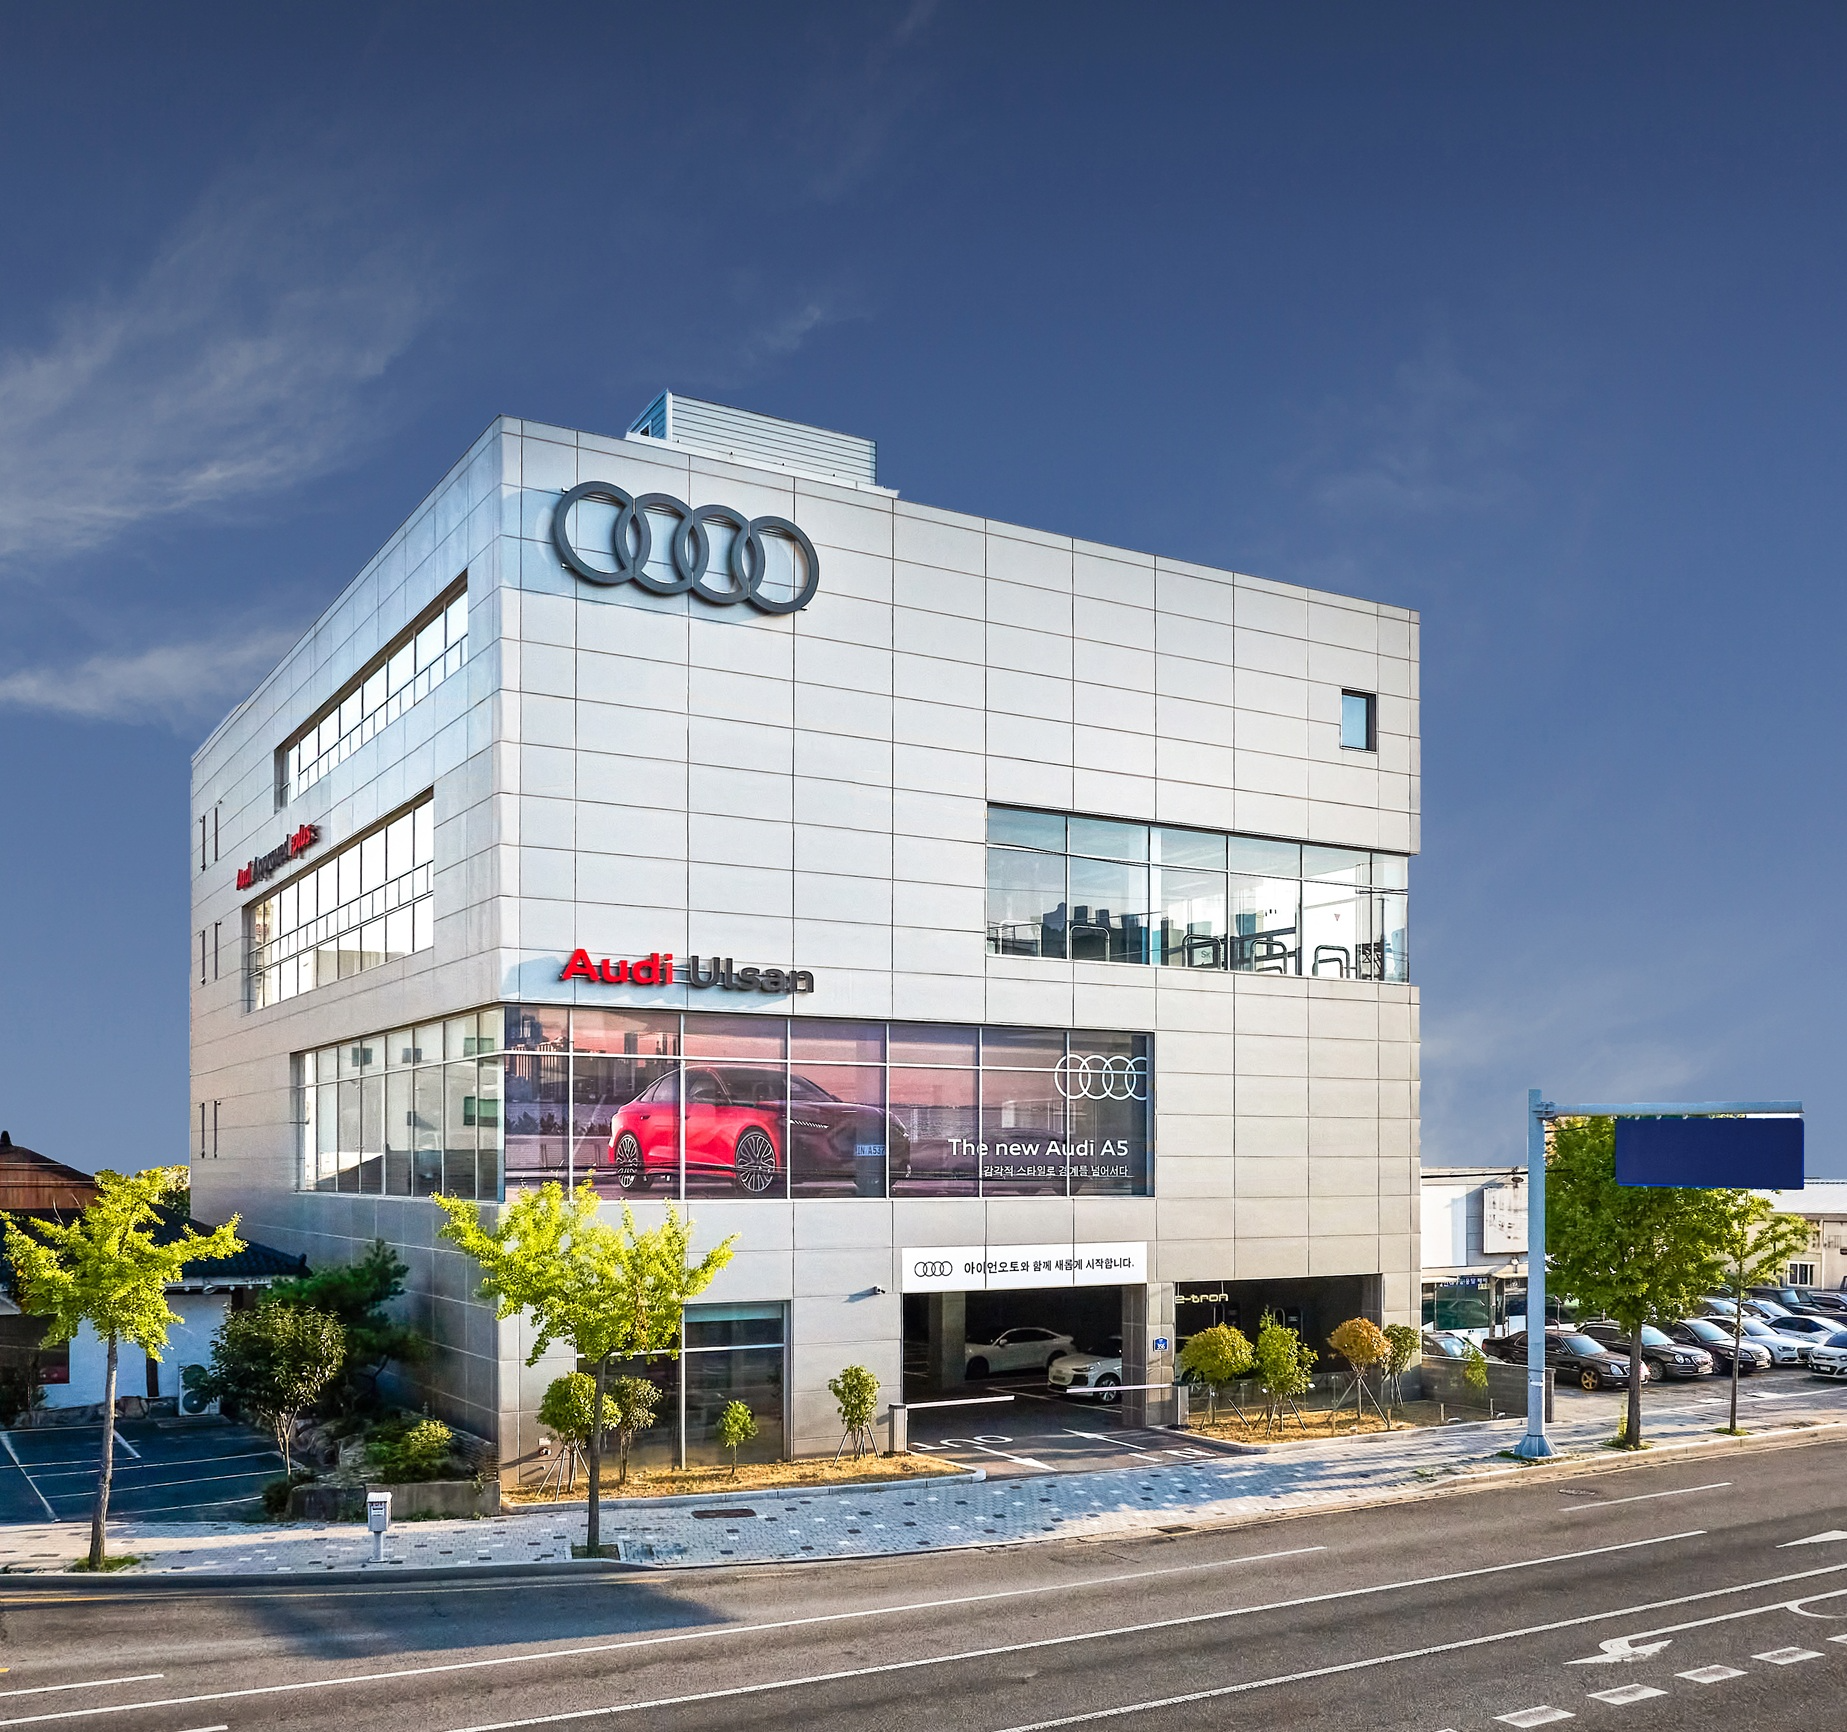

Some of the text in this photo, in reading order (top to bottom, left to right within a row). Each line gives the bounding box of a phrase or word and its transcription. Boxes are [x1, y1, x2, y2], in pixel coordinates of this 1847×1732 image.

[561, 948, 815, 993] Audi Ulsan
[947, 1138, 1129, 1157] The new Audi A5
[983, 1165, 1014, 1177] 감각적
[1016, 1165, 1056, 1177] 스타일로
[1091, 1165, 1129, 1177] 넘어서다
[964, 1257, 1135, 1275] 아이언오토와 함께 새롭게 시작합니다.
